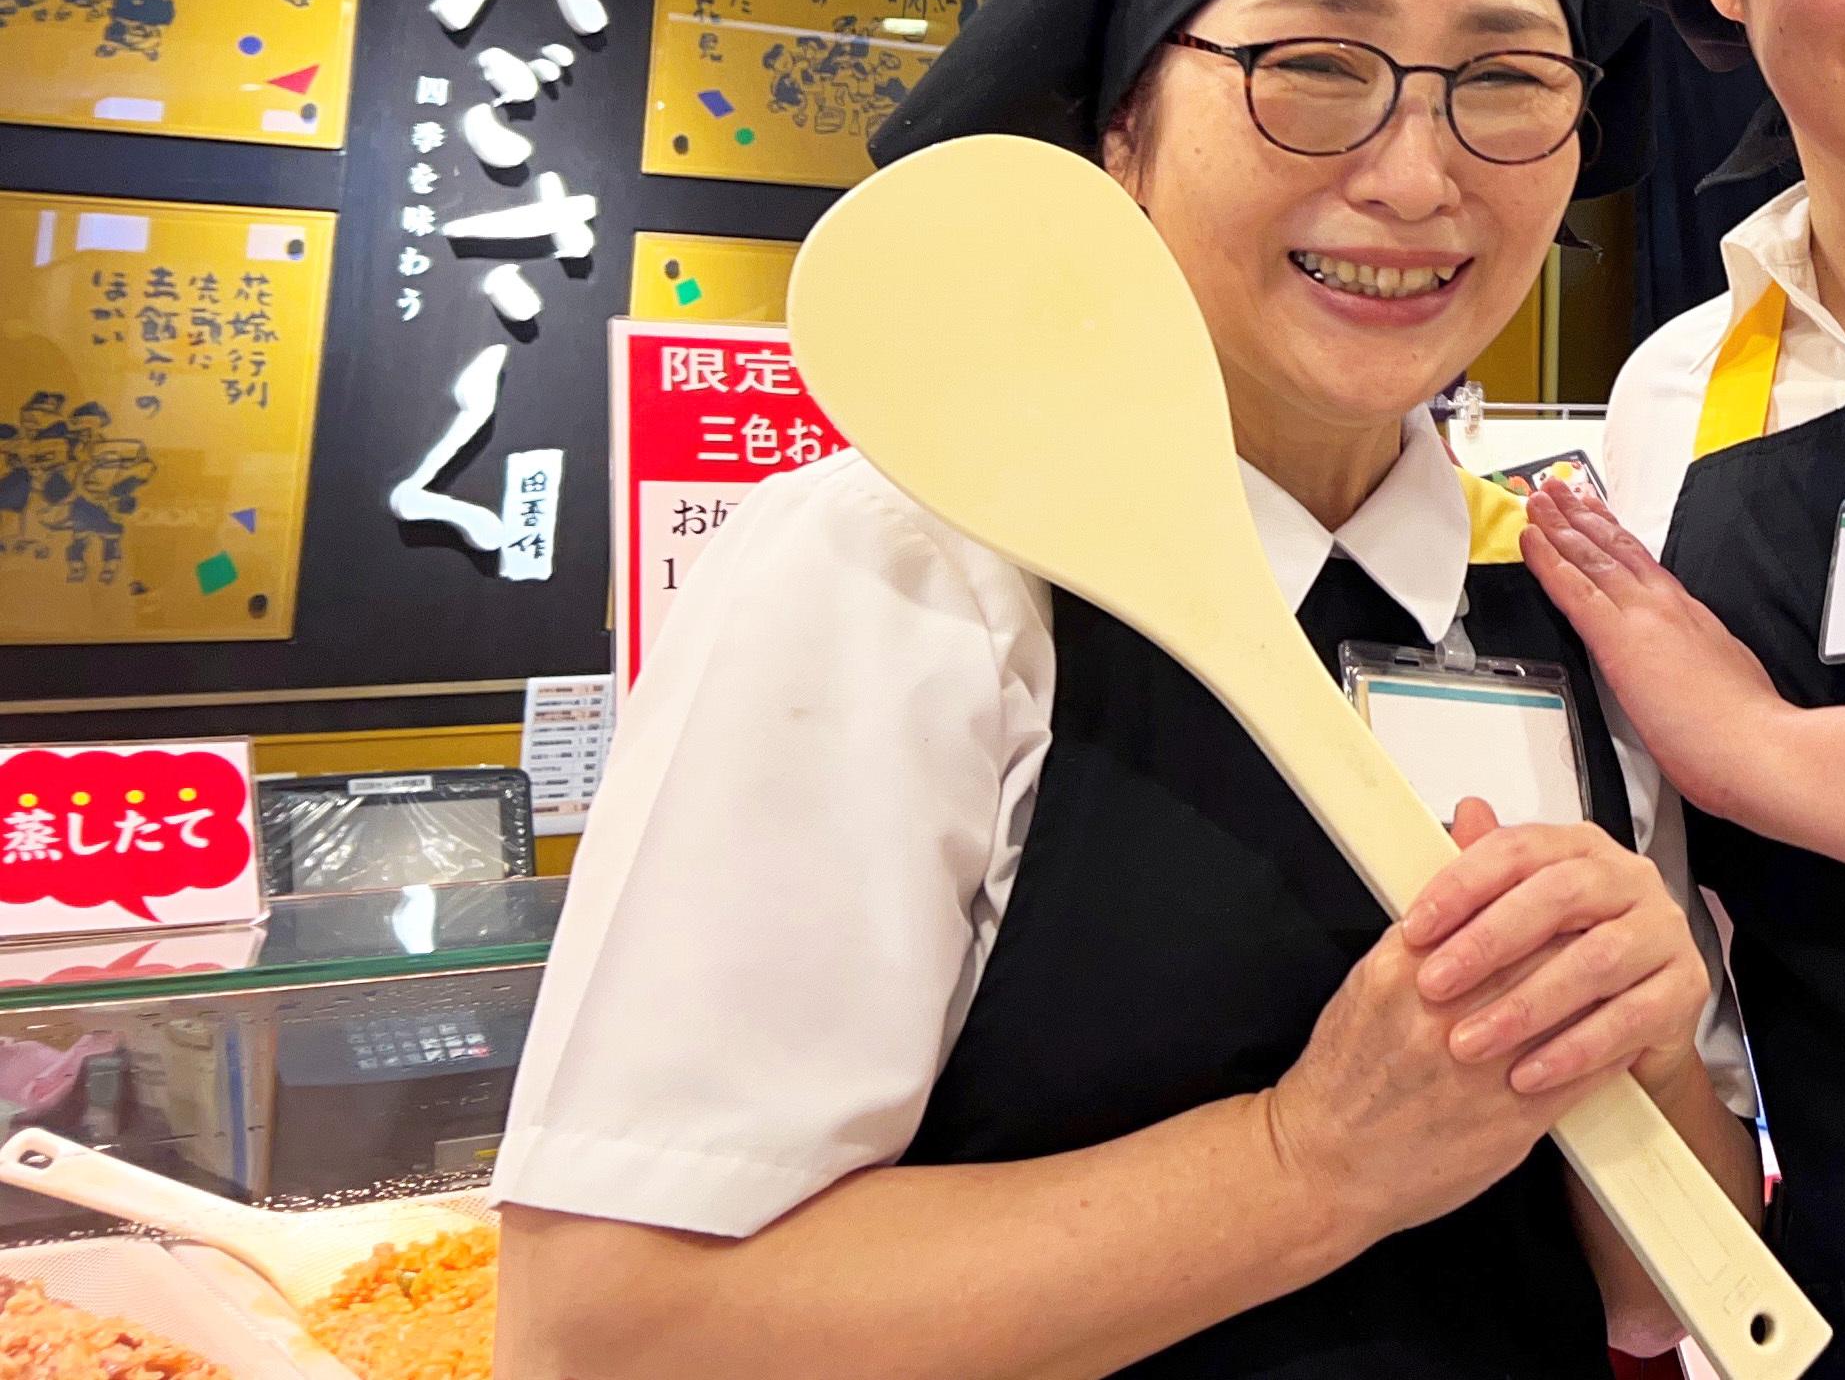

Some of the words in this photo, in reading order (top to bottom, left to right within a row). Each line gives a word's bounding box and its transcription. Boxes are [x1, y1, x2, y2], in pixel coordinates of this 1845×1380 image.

[396, 75, 452, 322] 四季を味わう
[661, 346, 811, 396] 限定
[697, 414, 840, 466] 三色お
[506, 470, 548, 559] 田吾作
[3, 805, 214, 865] 蒸したて
